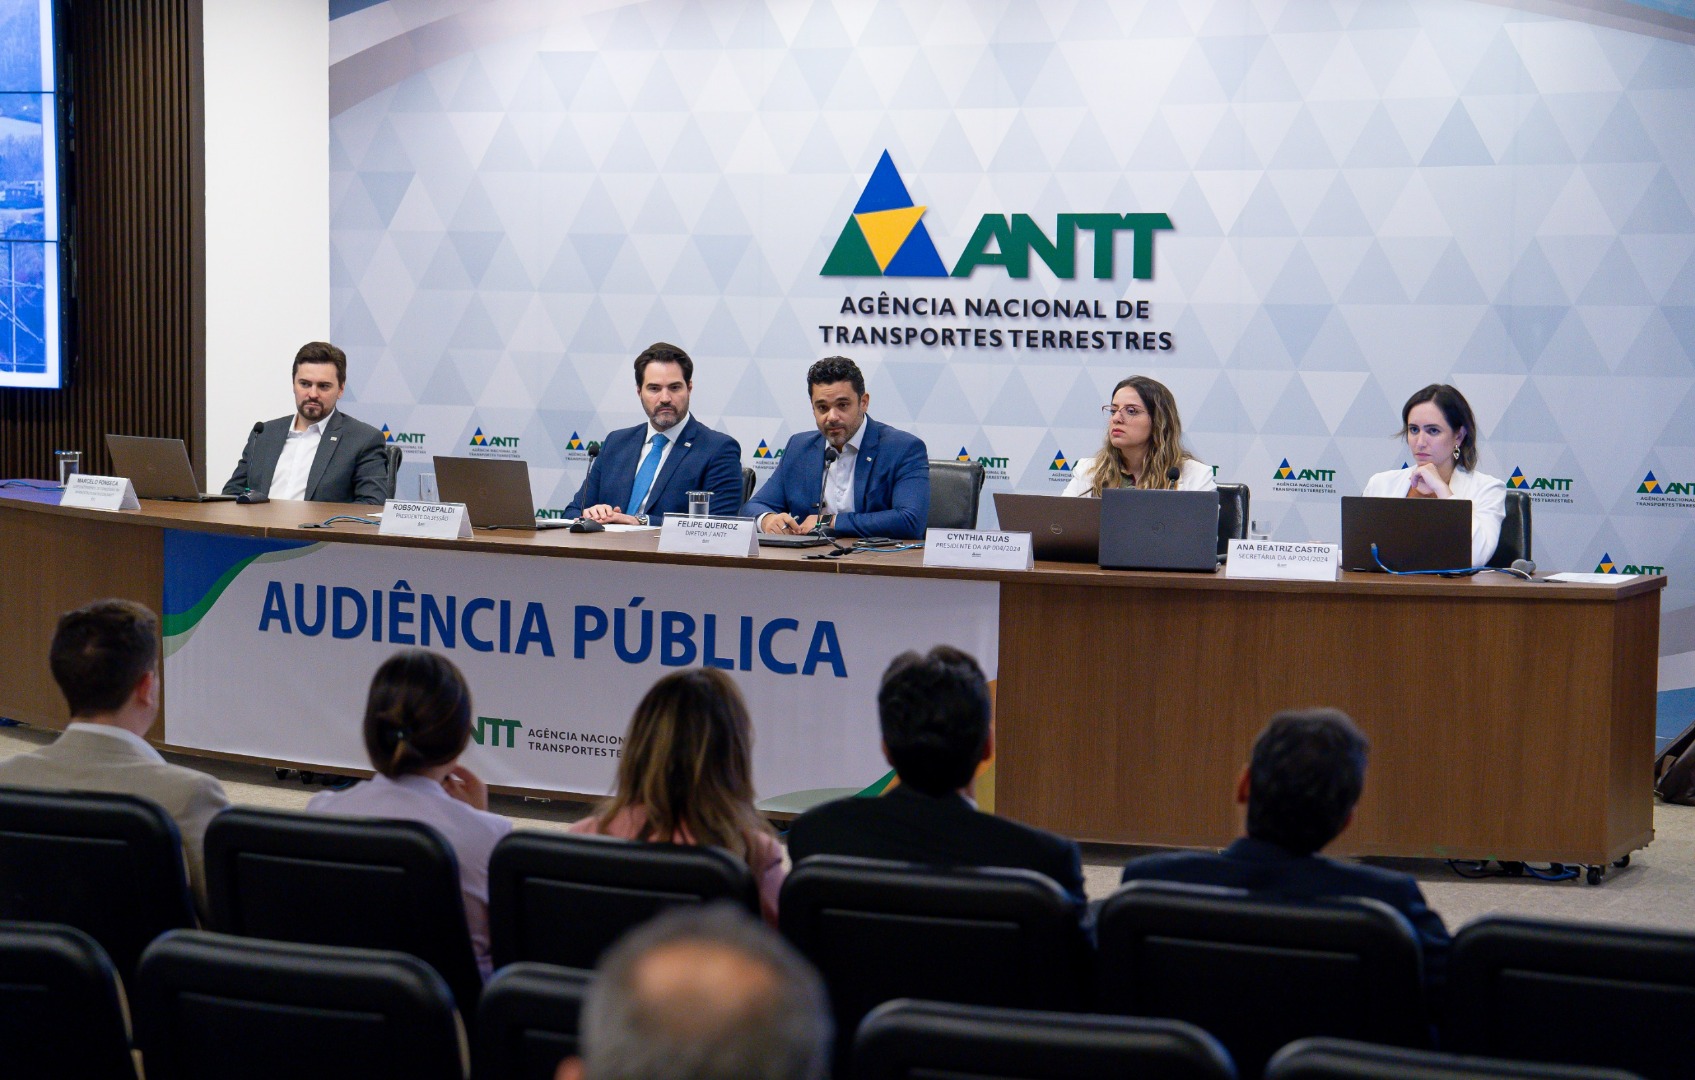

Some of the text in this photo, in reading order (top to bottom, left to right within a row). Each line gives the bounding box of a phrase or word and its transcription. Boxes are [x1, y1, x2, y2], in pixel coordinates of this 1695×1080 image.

[950, 213, 1174, 279] ANTT
[840, 291, 1149, 319] AGÊNCIA NACIONAL DE
[819, 325, 1173, 350] TRANSPORTES TERRESTRES
[396, 433, 426, 443] ANTT
[489, 436, 520, 448] ANTT
[977, 456, 1010, 468] ANTT
[1297, 469, 1337, 481] ANTT
[1530, 477, 1574, 490] ANTT
[1664, 482, 1695, 495] ANT
[393, 503, 455, 514] ROBSON CREPALDI
[677, 520, 739, 531] FELIPE QUEIROZ
[947, 533, 1010, 543] CYNTHIA RUAS
[1256, 544, 1293, 553] BEATRIZ
[1294, 545, 1331, 554] CASTRO
[1621, 564, 1664, 575] ANTT
[258, 579, 848, 678] AUDIÊNCIA PÚBLICA
[470, 716, 523, 749] NTT
[528, 727, 626, 745] AGÊNCIA NACION
[528, 741, 607, 757] TRANSPORTES
